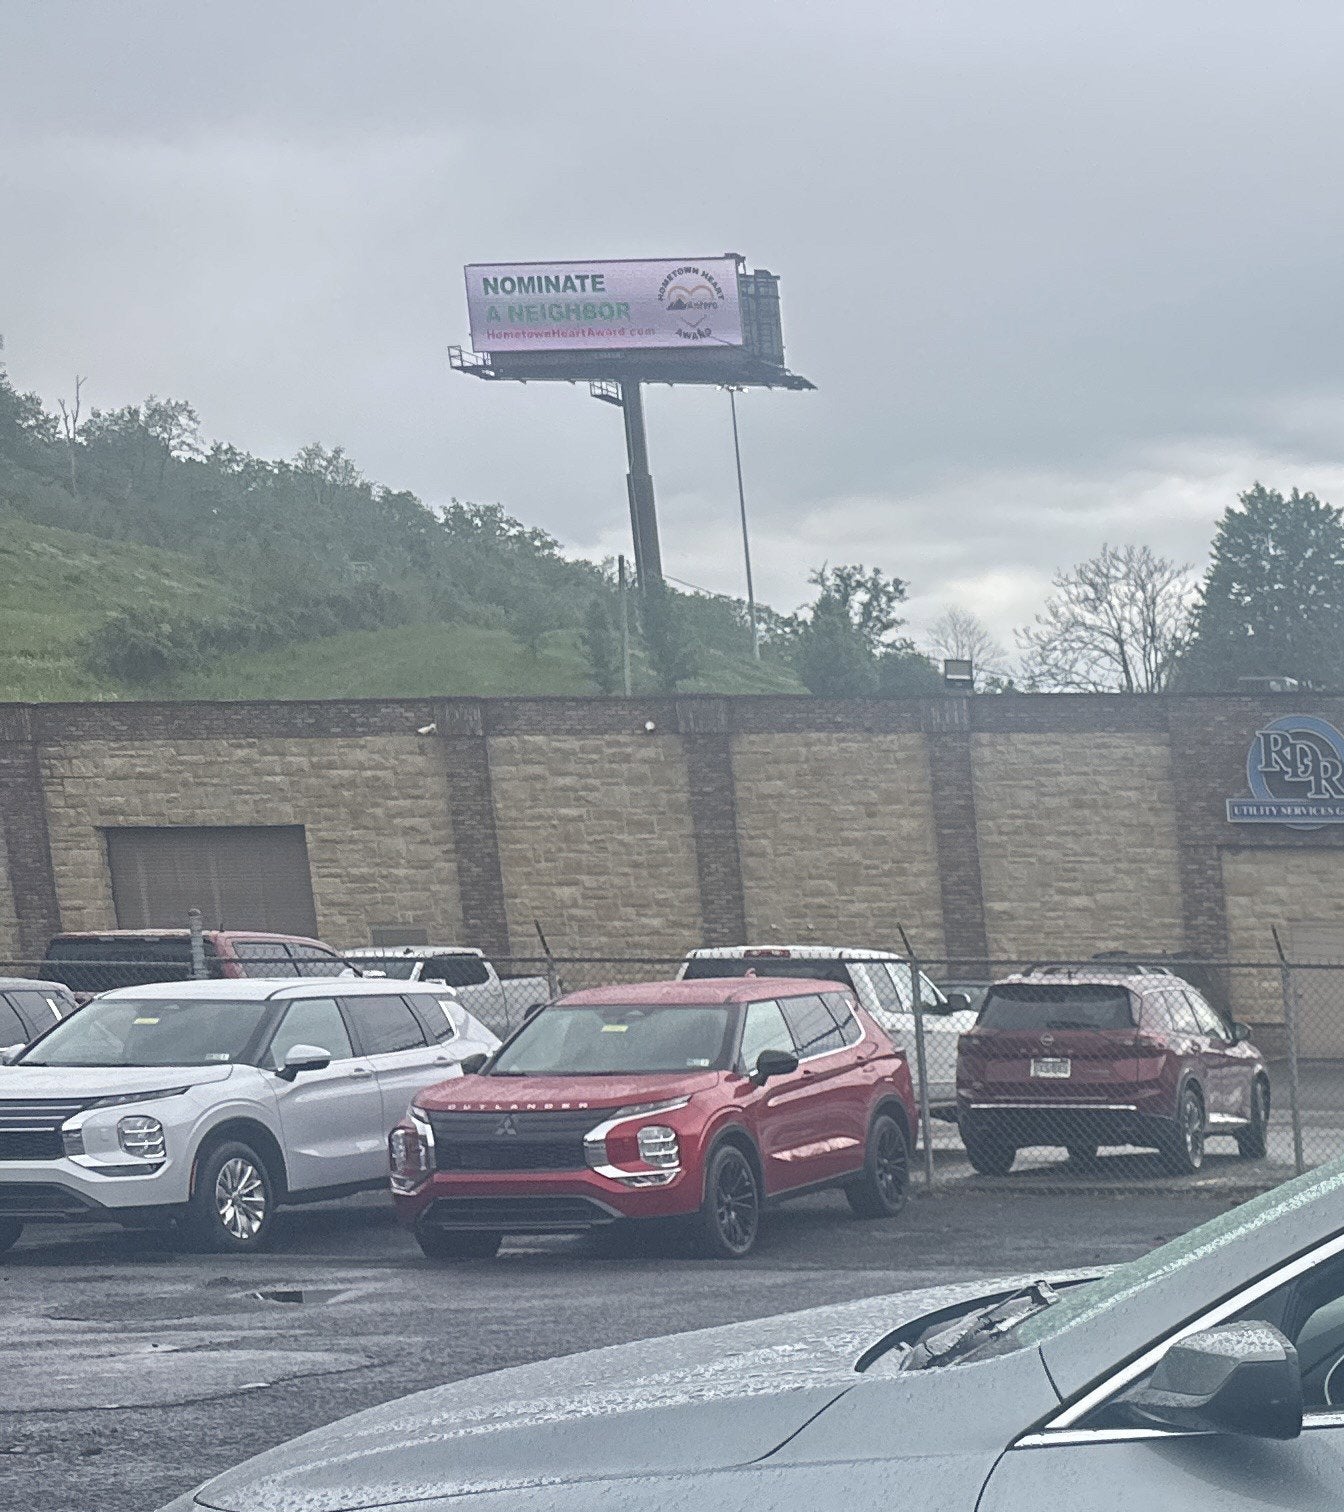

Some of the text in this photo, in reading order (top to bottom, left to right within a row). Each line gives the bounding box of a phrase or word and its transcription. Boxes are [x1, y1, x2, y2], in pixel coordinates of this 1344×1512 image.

[482, 274, 605, 295] NOMINATE
[658, 266, 725, 301] HOMETOWN HEART
[486, 301, 631, 323] A NEIGHBOR
[675, 327, 712, 341] AWARD
[1233, 805, 1278, 816] UTILITY
[1280, 805, 1334, 816] SERVICES
